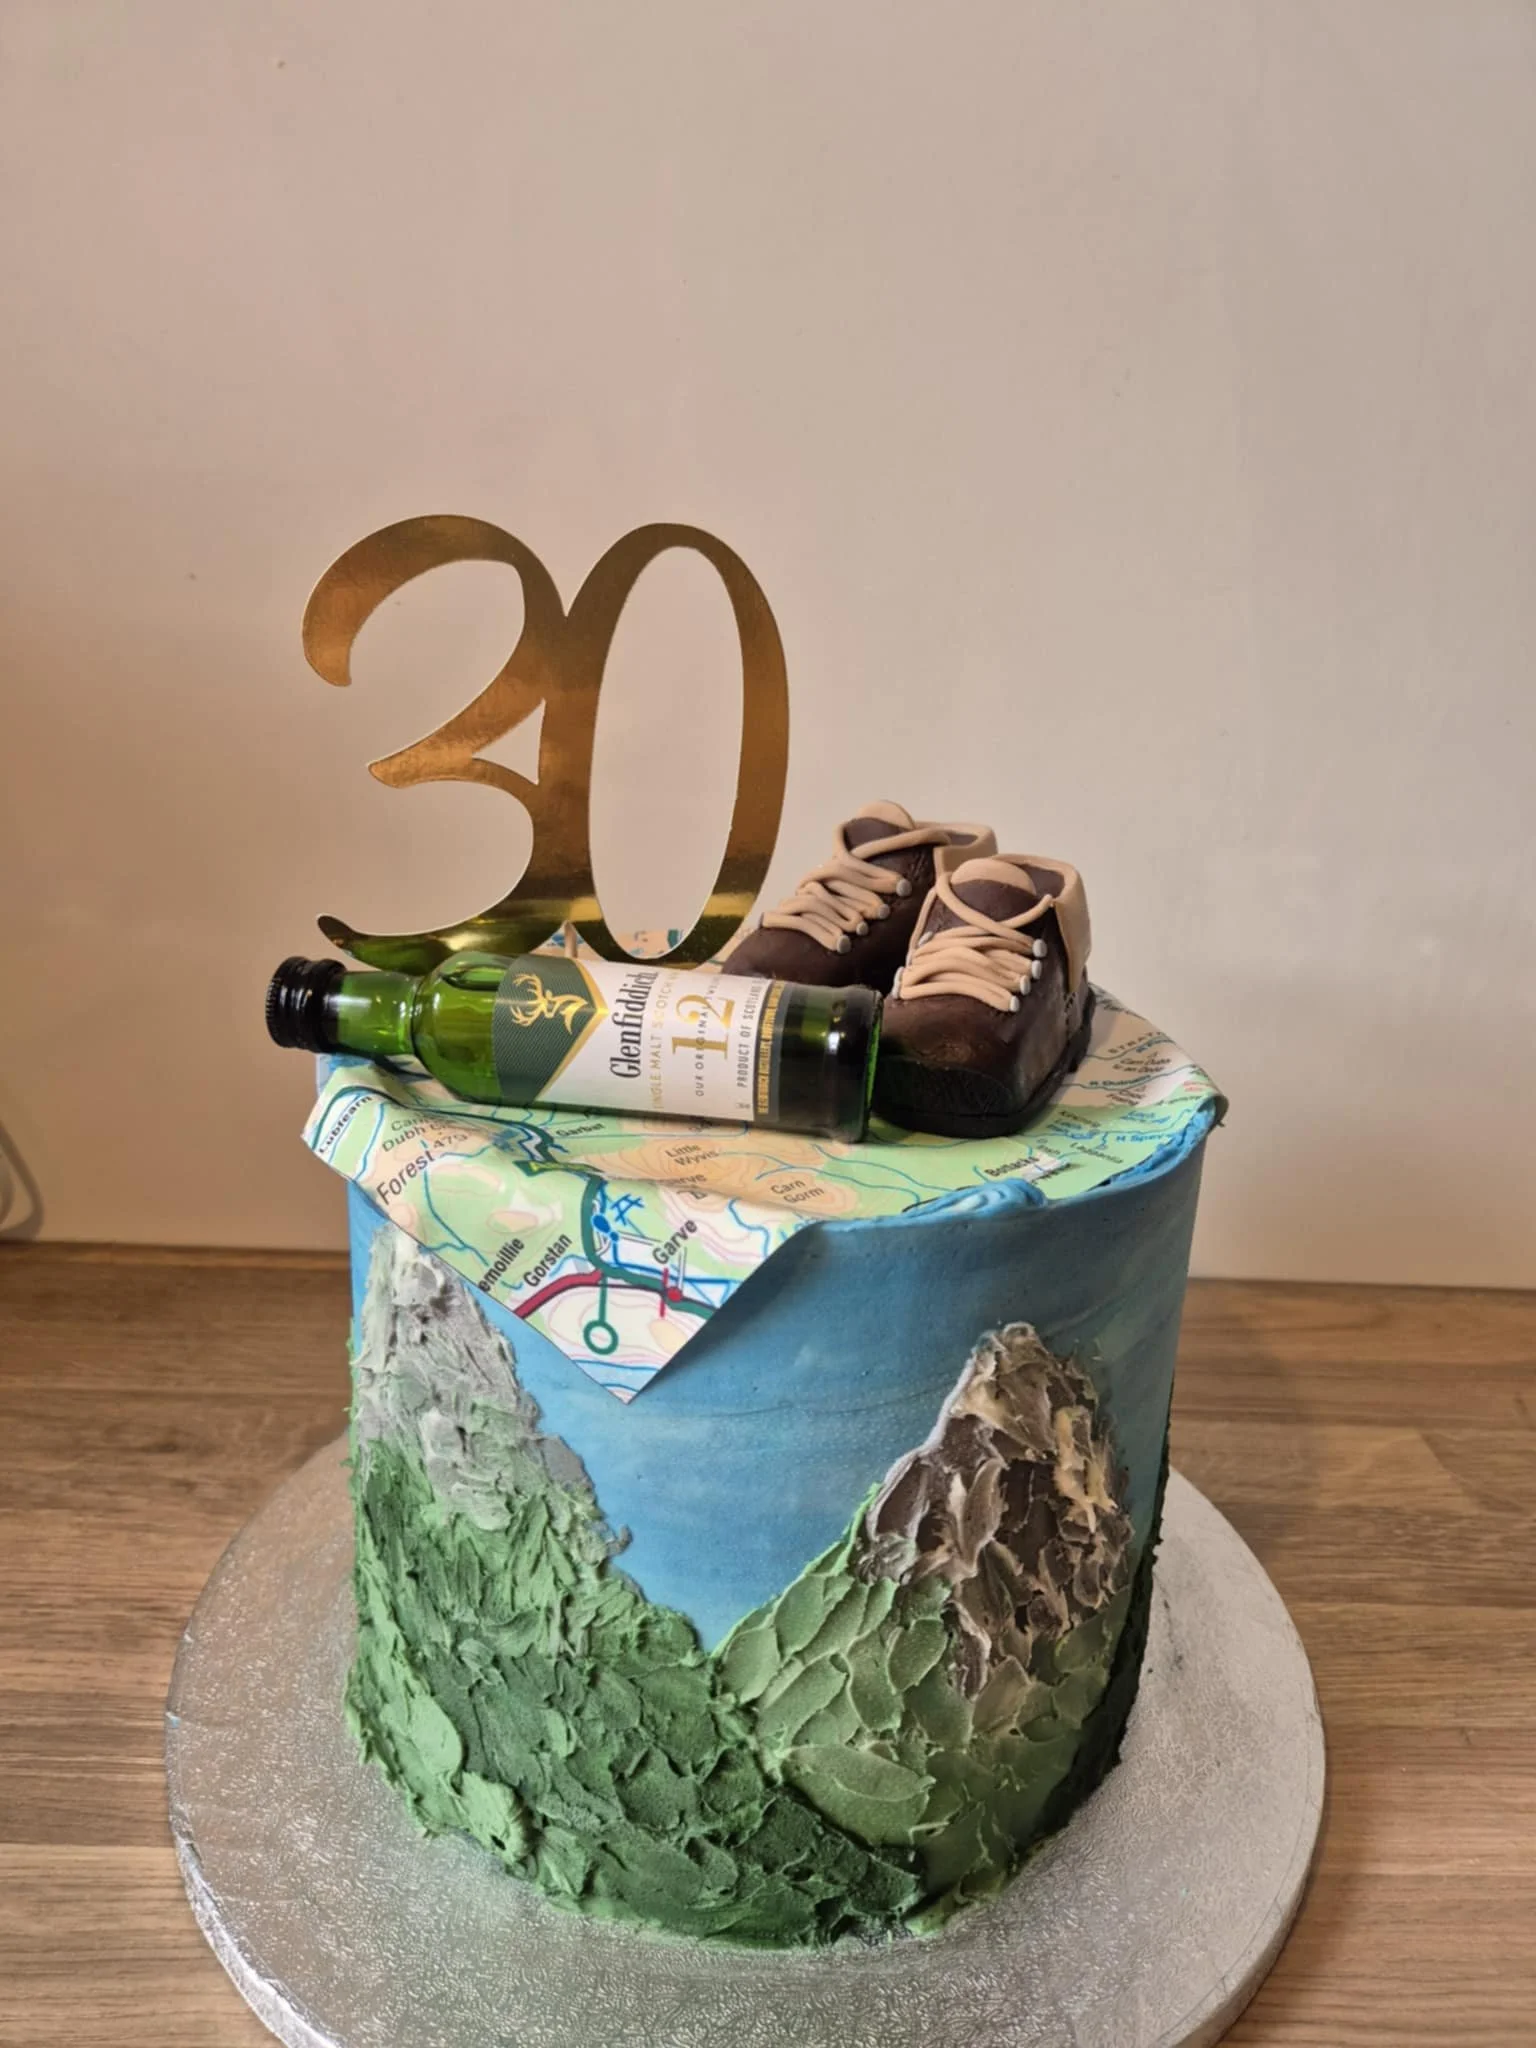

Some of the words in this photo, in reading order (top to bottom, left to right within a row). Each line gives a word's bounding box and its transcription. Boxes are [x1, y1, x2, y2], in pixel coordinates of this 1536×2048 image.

[302, 514, 789, 972] 30
[609, 971, 659, 1079] Glenfiddich
[651, 981, 673, 1028] SCOTCH
[671, 994, 735, 1060] 12
[649, 1035, 663, 1069] MALT
[694, 1006, 709, 1070] ORIGINAL
[739, 1024, 752, 1038] OF
[694, 1075, 705, 1097] OUR
[736, 1043, 750, 1088] PRODUCT
[381, 1126, 427, 1152] Dubh
[665, 1145, 701, 1158] Little
[674, 1151, 719, 1166] Wyvis
[375, 1149, 435, 1206] Forest
[770, 1179, 807, 1196] Carn
[783, 1186, 825, 1204] Gorm
[479, 1236, 525, 1293] emoillie
[523, 1233, 573, 1288] Gorstan
[652, 1218, 699, 1266] Garve
